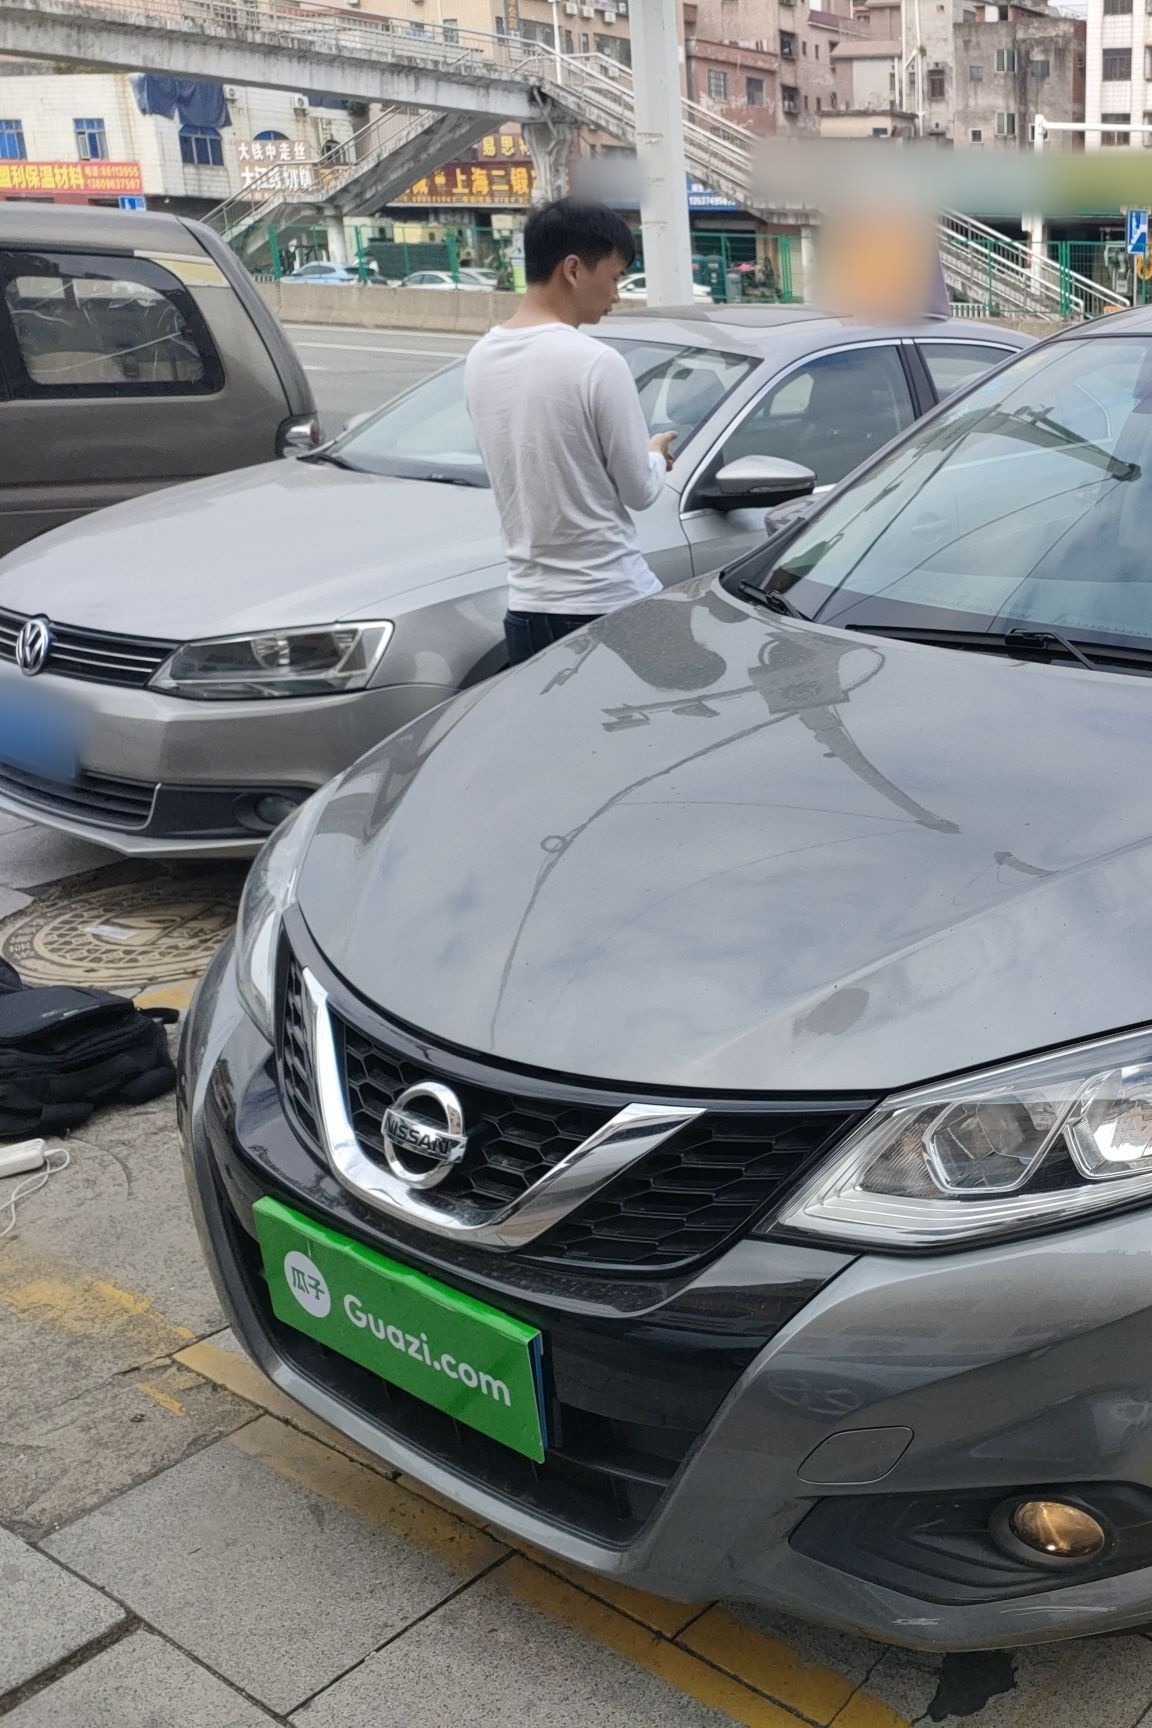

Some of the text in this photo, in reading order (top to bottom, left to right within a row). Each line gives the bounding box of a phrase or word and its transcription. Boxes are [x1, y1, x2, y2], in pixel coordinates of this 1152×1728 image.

[387, 1113, 450, 1155] NISSAN
[291, 1266, 512, 1407] 瓜子 Guazi.com
